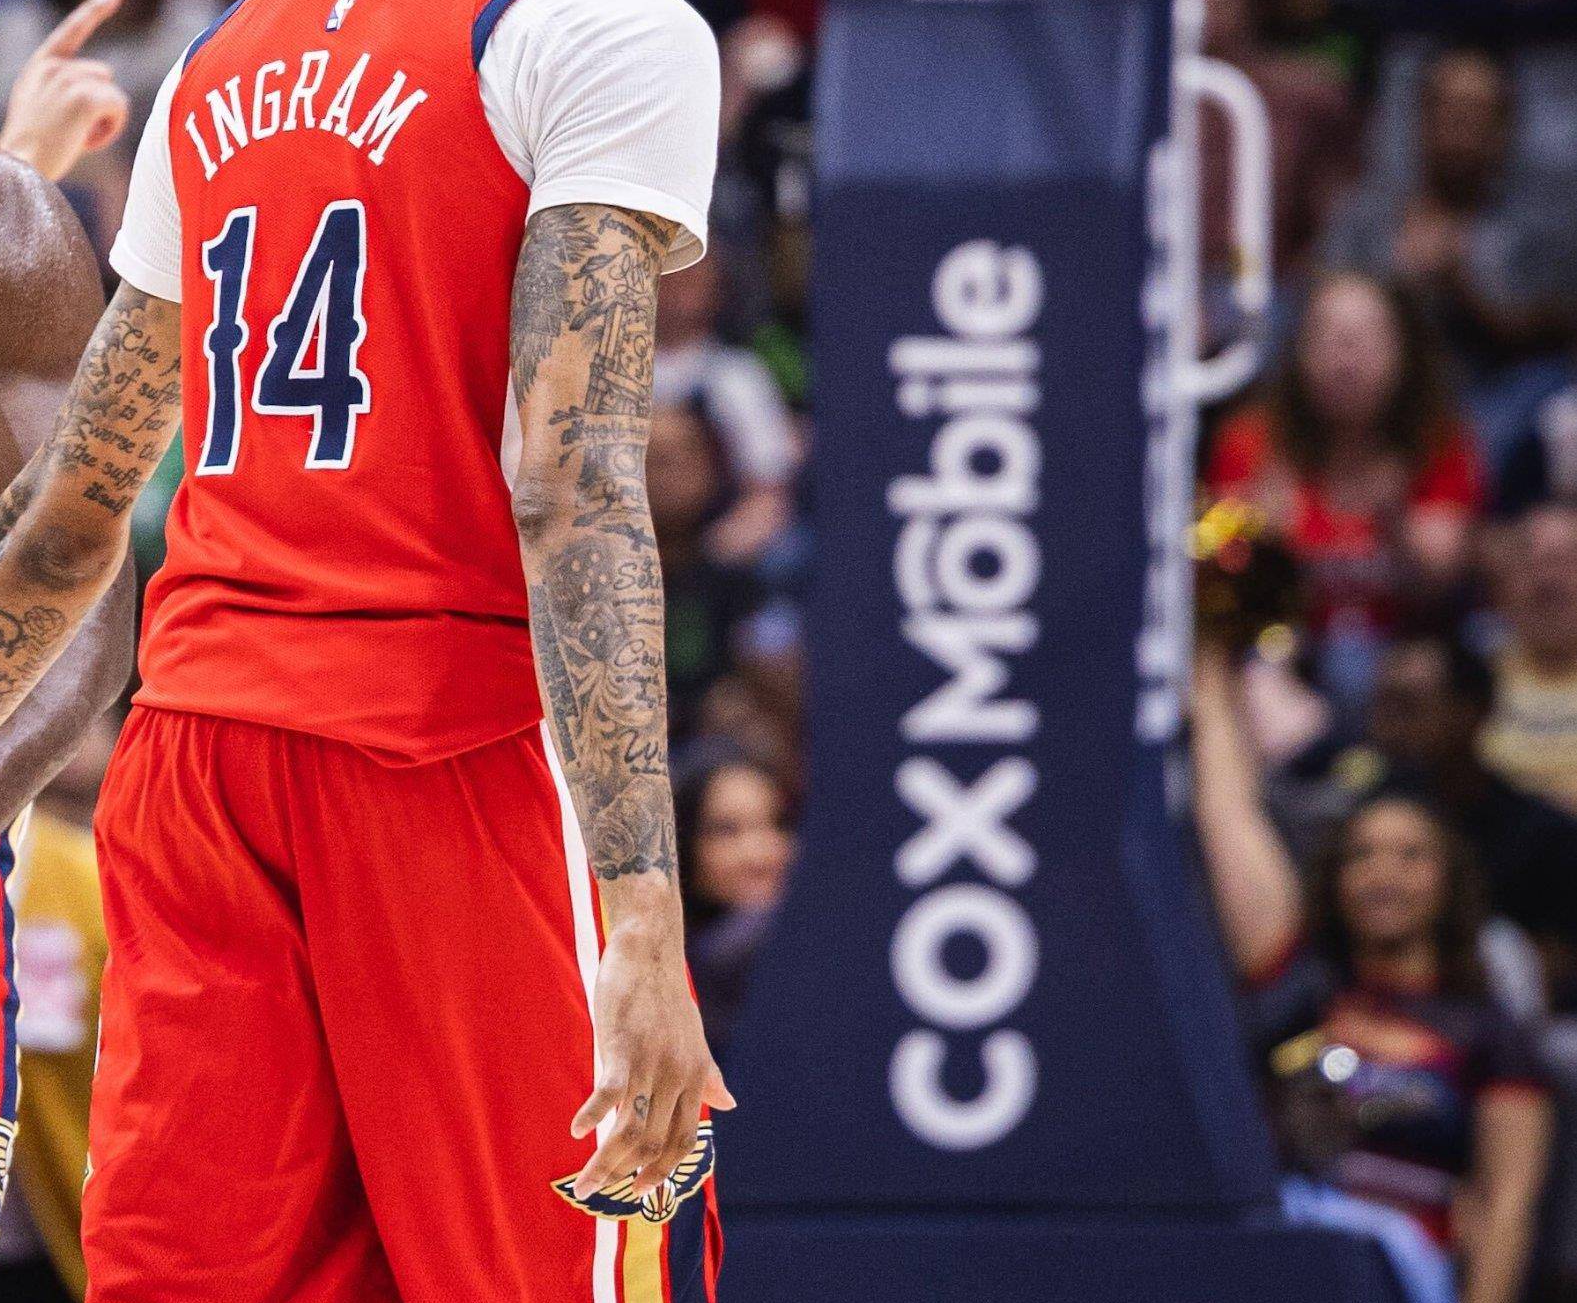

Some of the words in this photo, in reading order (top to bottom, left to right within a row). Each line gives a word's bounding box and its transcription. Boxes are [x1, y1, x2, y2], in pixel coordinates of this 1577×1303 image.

[184, 48, 428, 182] INGRAM
[194, 198, 371, 476] 14
[886, 237, 1045, 743] Mobile
[887, 752, 1040, 1152] COX
